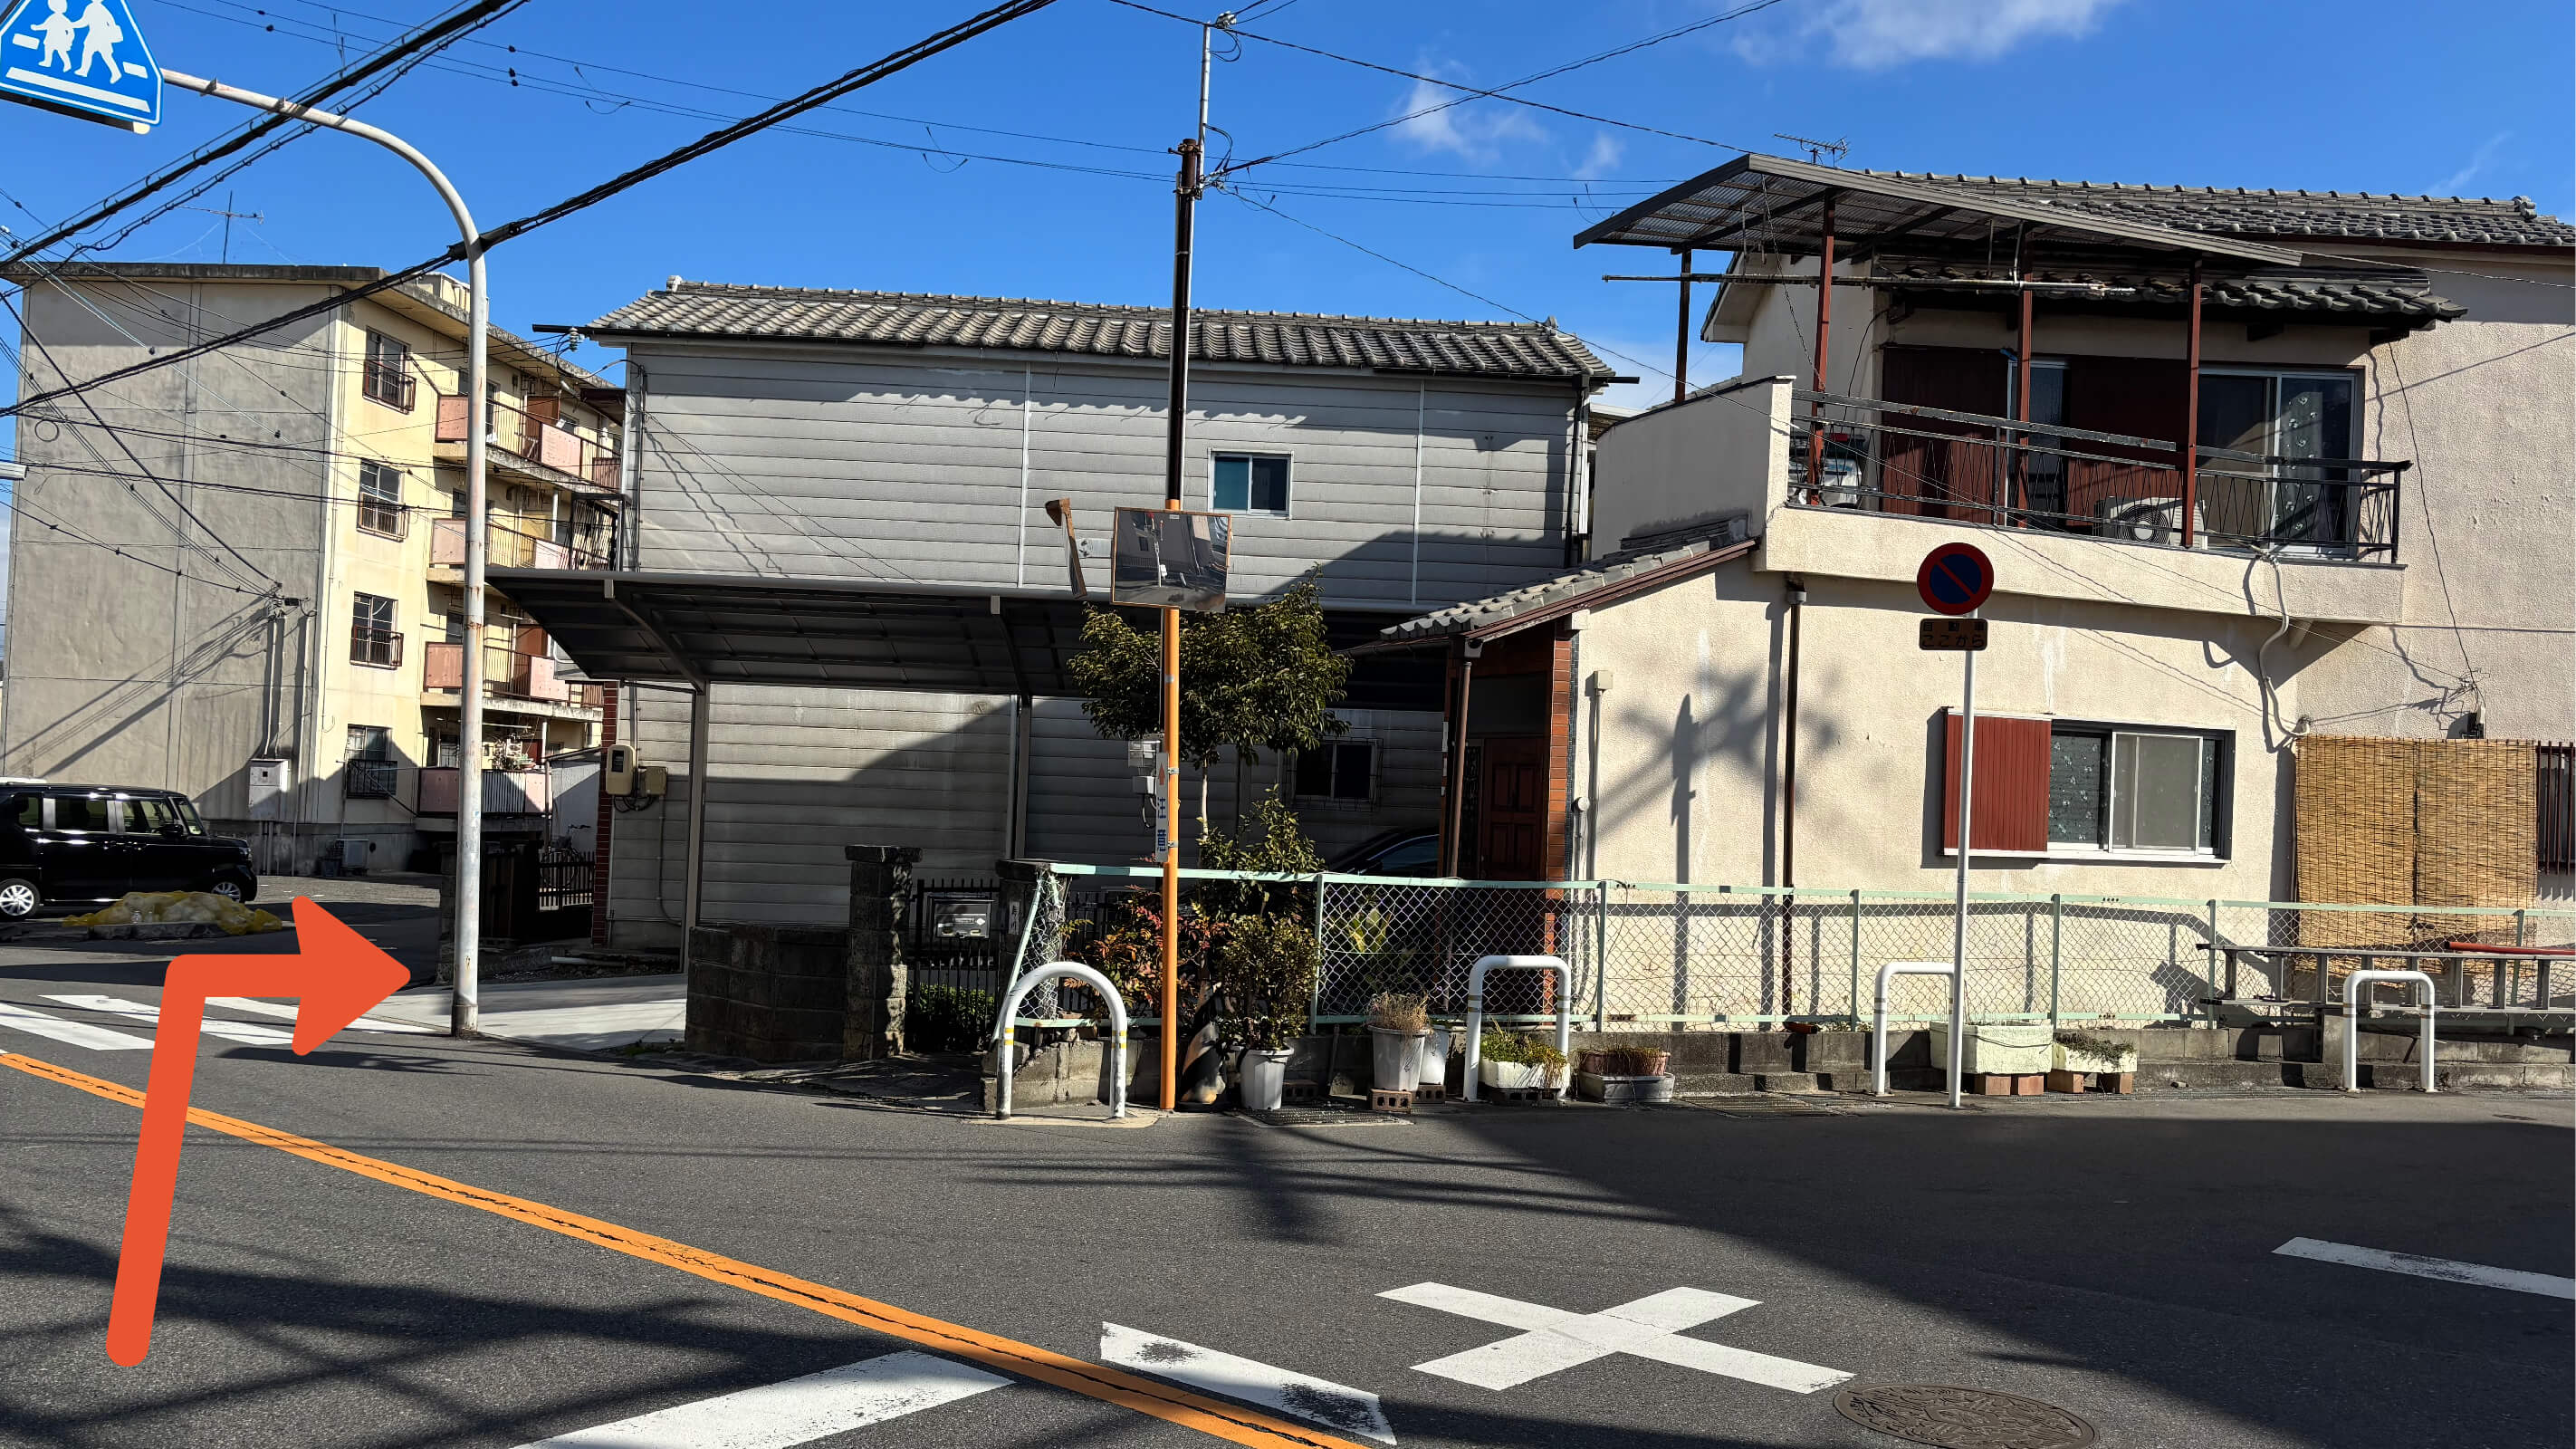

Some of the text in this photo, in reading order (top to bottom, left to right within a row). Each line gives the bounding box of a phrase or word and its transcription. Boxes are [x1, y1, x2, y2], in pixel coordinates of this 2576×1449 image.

[1921, 634, 1985, 648] ここから
[1157, 797, 1167, 851] 注意
